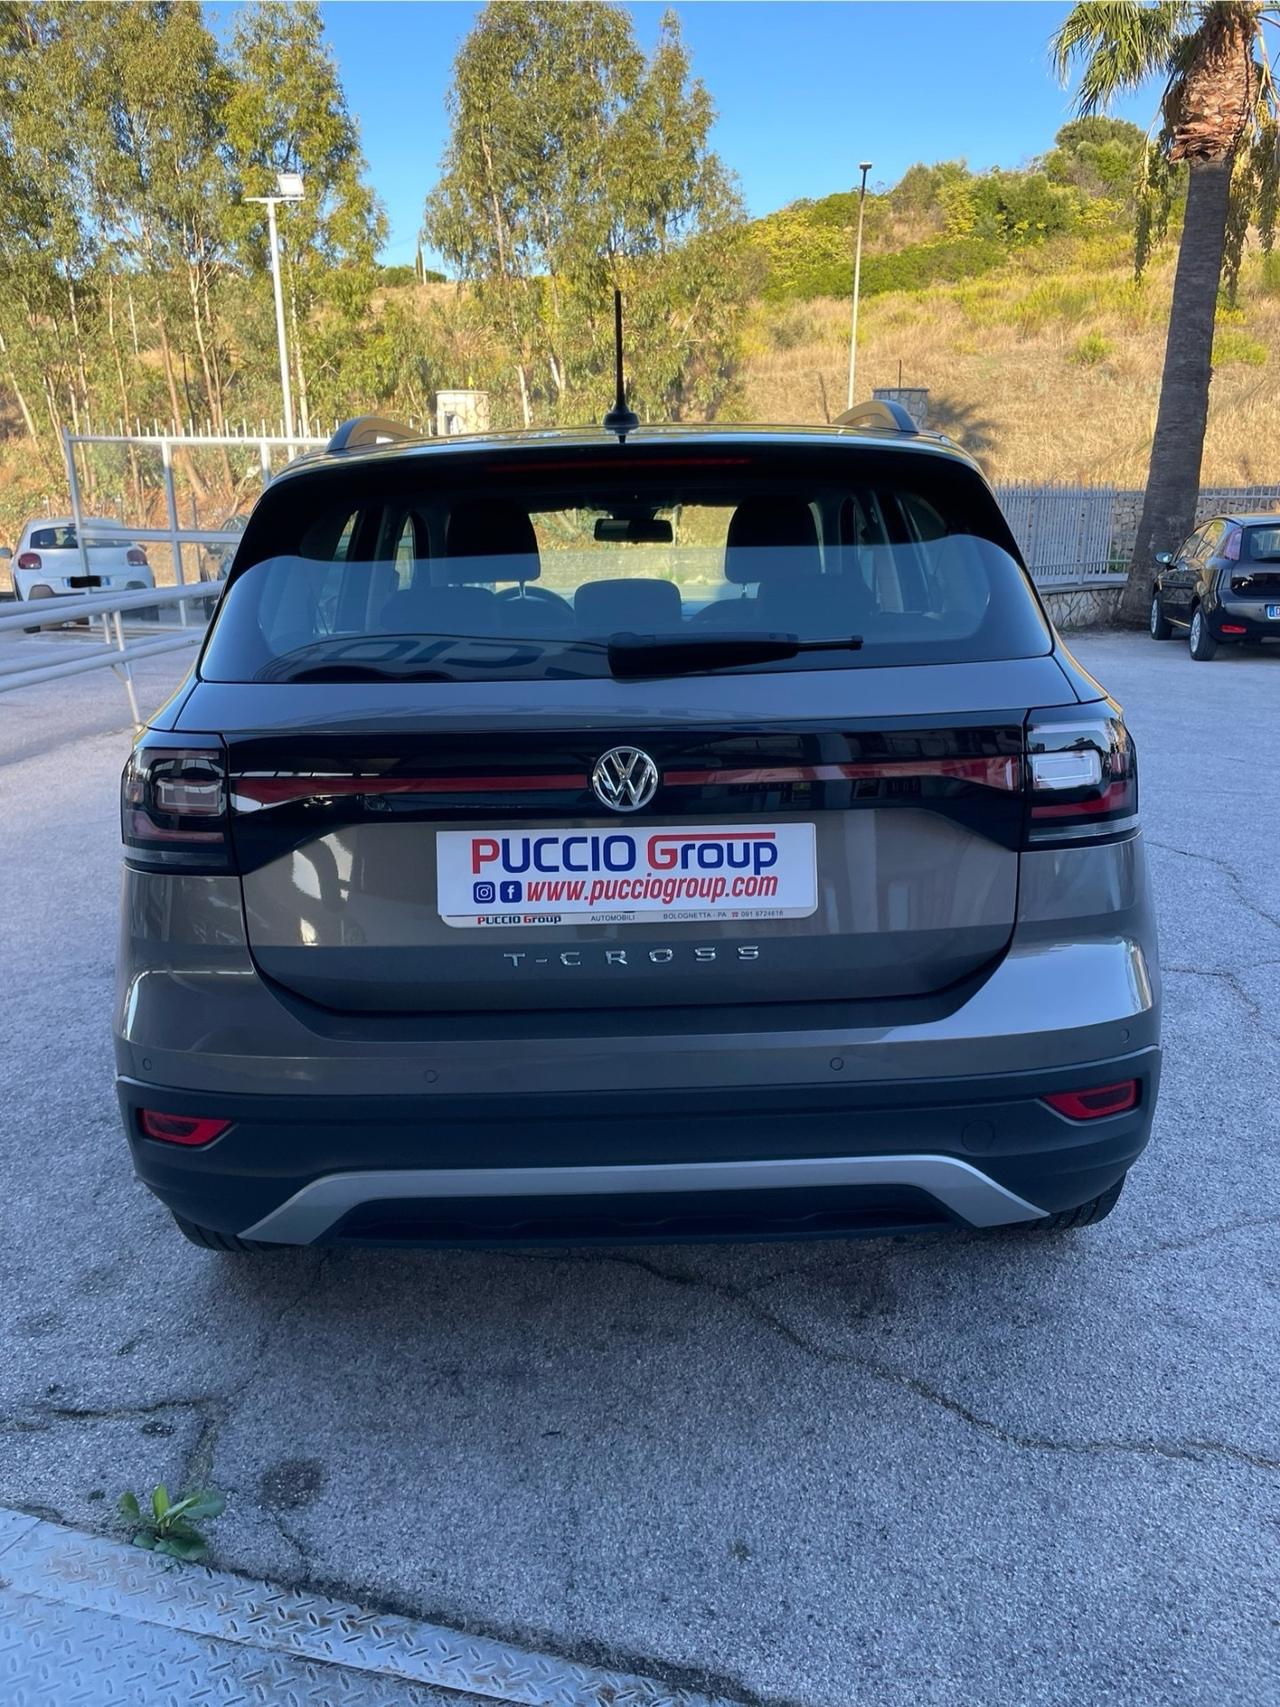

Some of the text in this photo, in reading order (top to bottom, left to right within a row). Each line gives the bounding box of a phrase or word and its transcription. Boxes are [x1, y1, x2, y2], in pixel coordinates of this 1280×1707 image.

[472, 832, 778, 876] PUCCIO Group
[527, 873, 778, 906] www.pucciogroup.com
[477, 912, 562, 925] PUCCIO Group
[590, 914, 636, 922] AUTOMOBILI
[663, 911, 712, 920] BOLOGNETTA
[504, 945, 759, 967] T-CROSS
